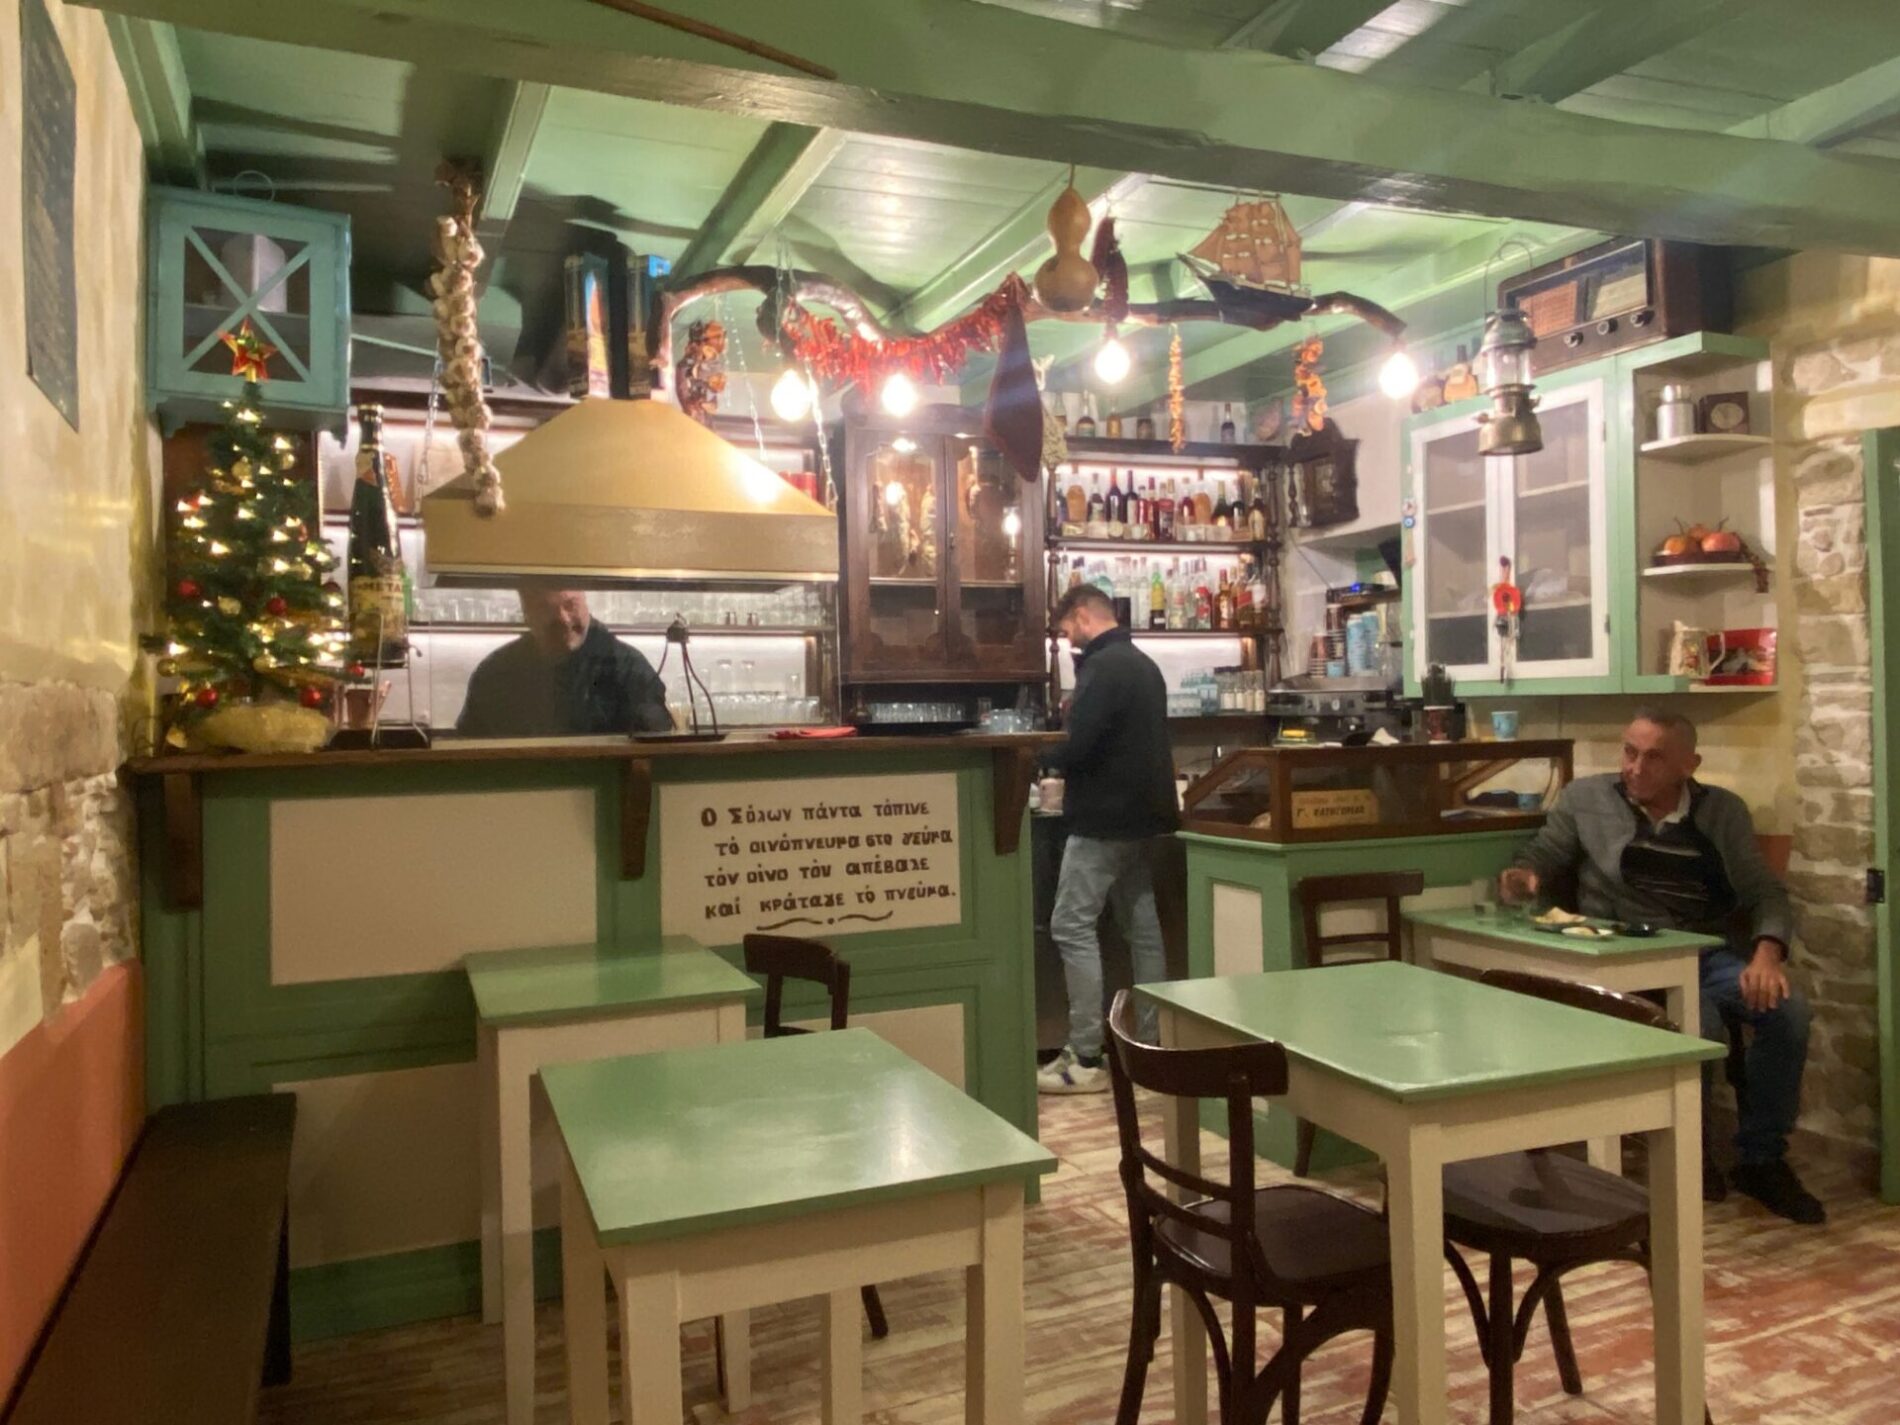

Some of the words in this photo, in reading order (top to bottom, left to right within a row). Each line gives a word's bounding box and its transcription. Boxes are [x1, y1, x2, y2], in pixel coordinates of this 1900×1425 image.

[728, 804, 792, 825] Σόλων
[802, 801, 862, 821] πάντα
[750, 832, 861, 854] οινόπνευμα
[866, 834, 893, 848] στο
[902, 825, 954, 847] γεύμα
[747, 863, 789, 884] οίνο
[846, 854, 931, 876] απέβαλε
[759, 892, 845, 914] κράταγε
